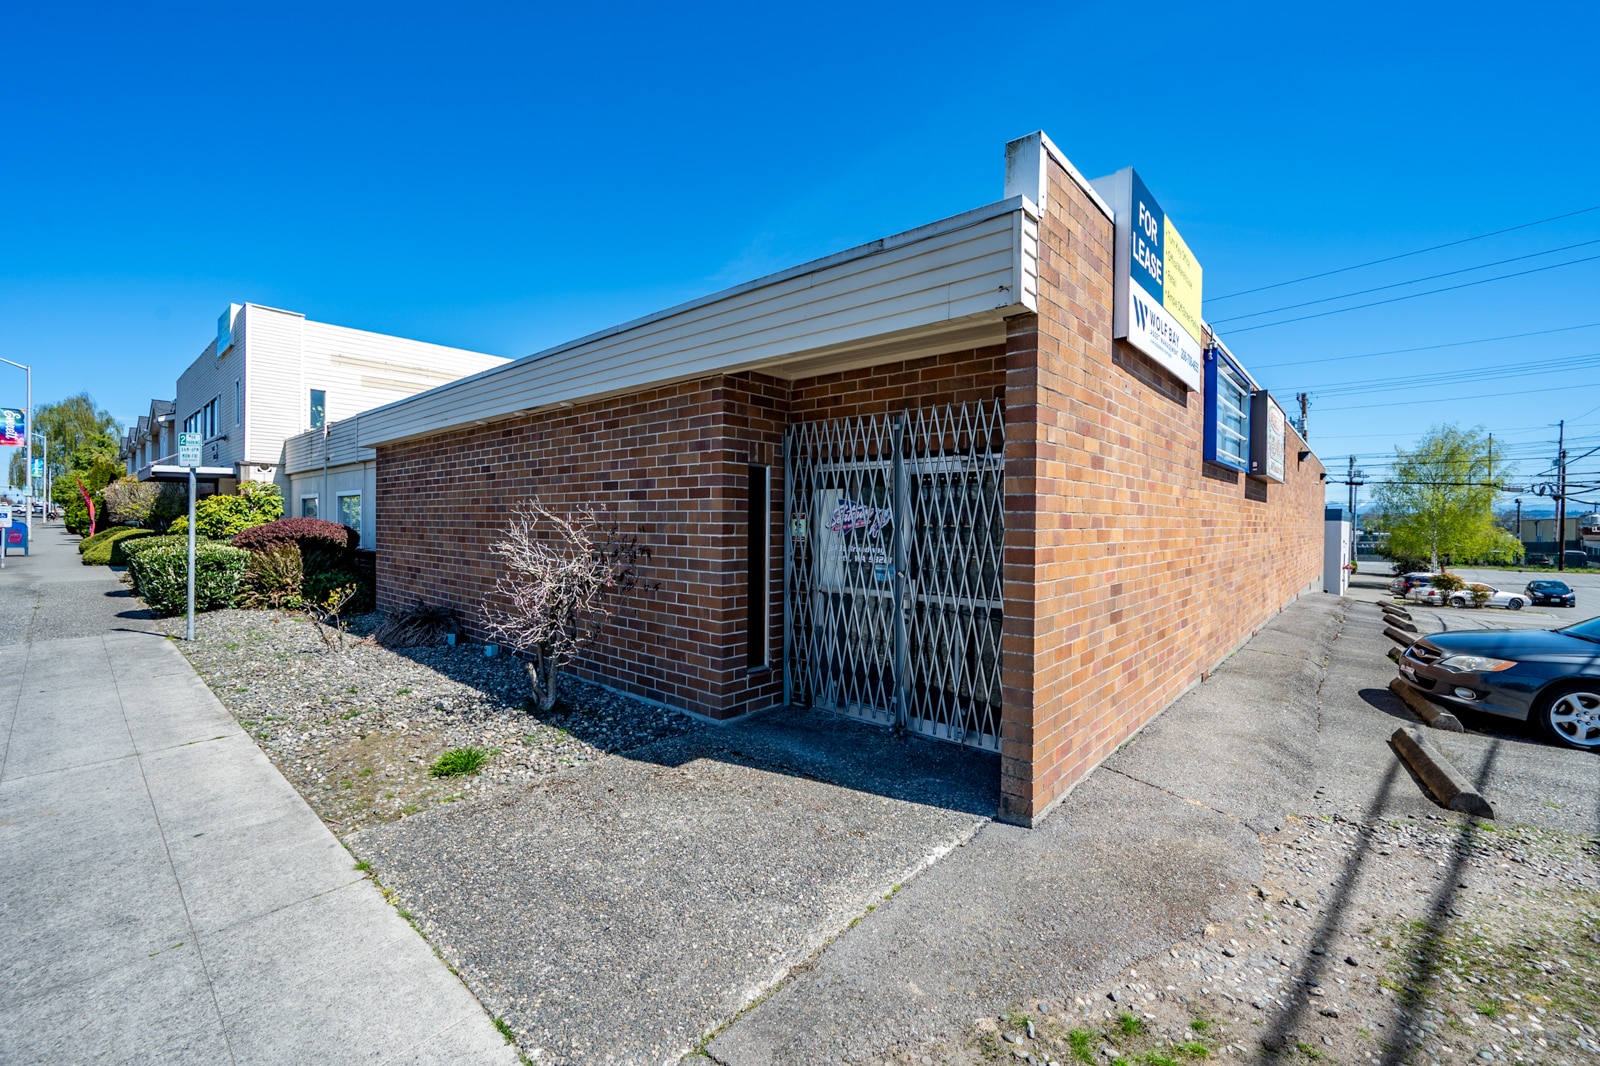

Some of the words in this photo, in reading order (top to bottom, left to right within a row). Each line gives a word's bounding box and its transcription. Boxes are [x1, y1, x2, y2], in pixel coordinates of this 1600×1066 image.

[1139, 200, 1158, 246] FOR
[1132, 231, 1162, 286] LEASE
[1150, 309, 1167, 336] WOLF
[1168, 326, 1180, 348] BAY
[3, 410, 21, 440] Everett
[180, 435, 186, 445] 2
